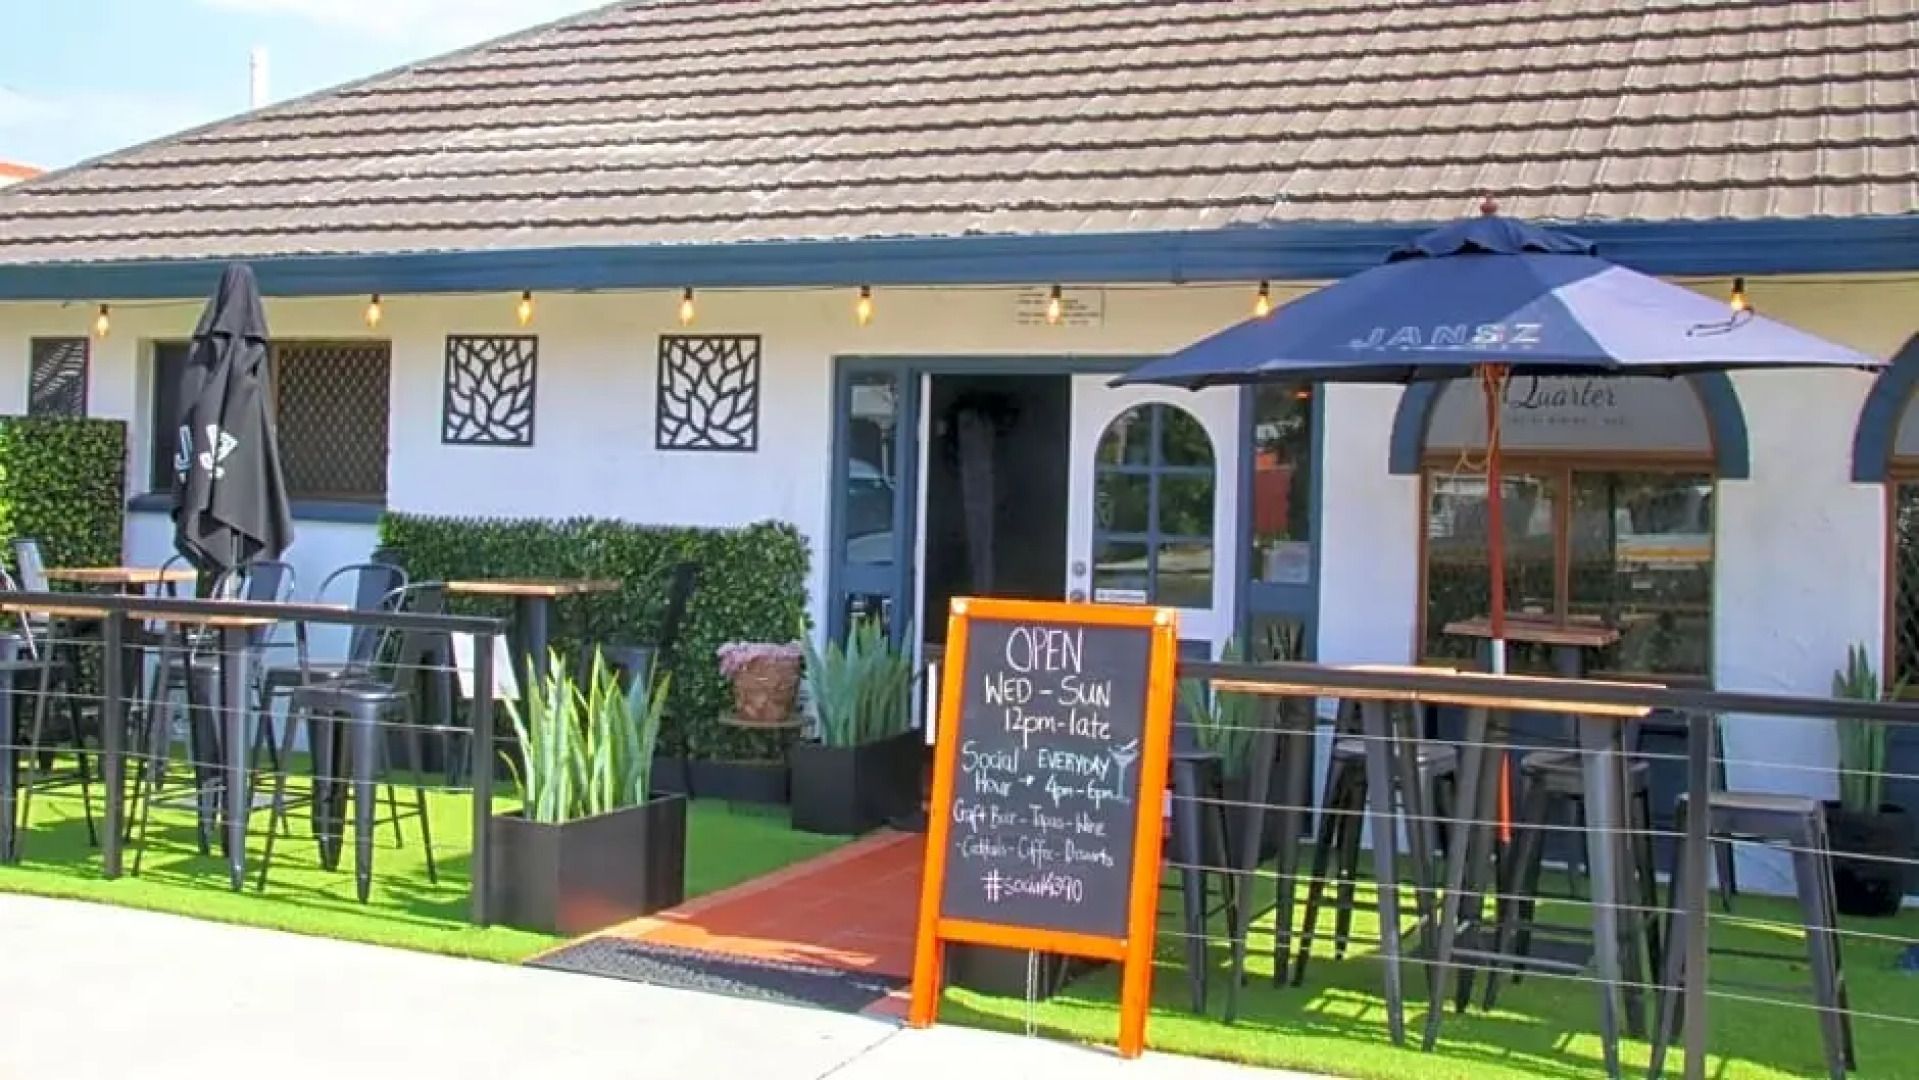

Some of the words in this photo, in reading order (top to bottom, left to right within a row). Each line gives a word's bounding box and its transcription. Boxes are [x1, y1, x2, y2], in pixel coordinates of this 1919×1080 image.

[1349, 322, 1543, 348] JANSZ
[1502, 376, 1618, 409] Quarter
[1006, 626, 1082, 673] OPEN
[985, 671, 1032, 705] WED
[1058, 675, 1111, 707] SUN
[962, 740, 1019, 773] Social
[1038, 749, 1110, 782] EVERYDAY
[975, 769, 1012, 797] Hour
